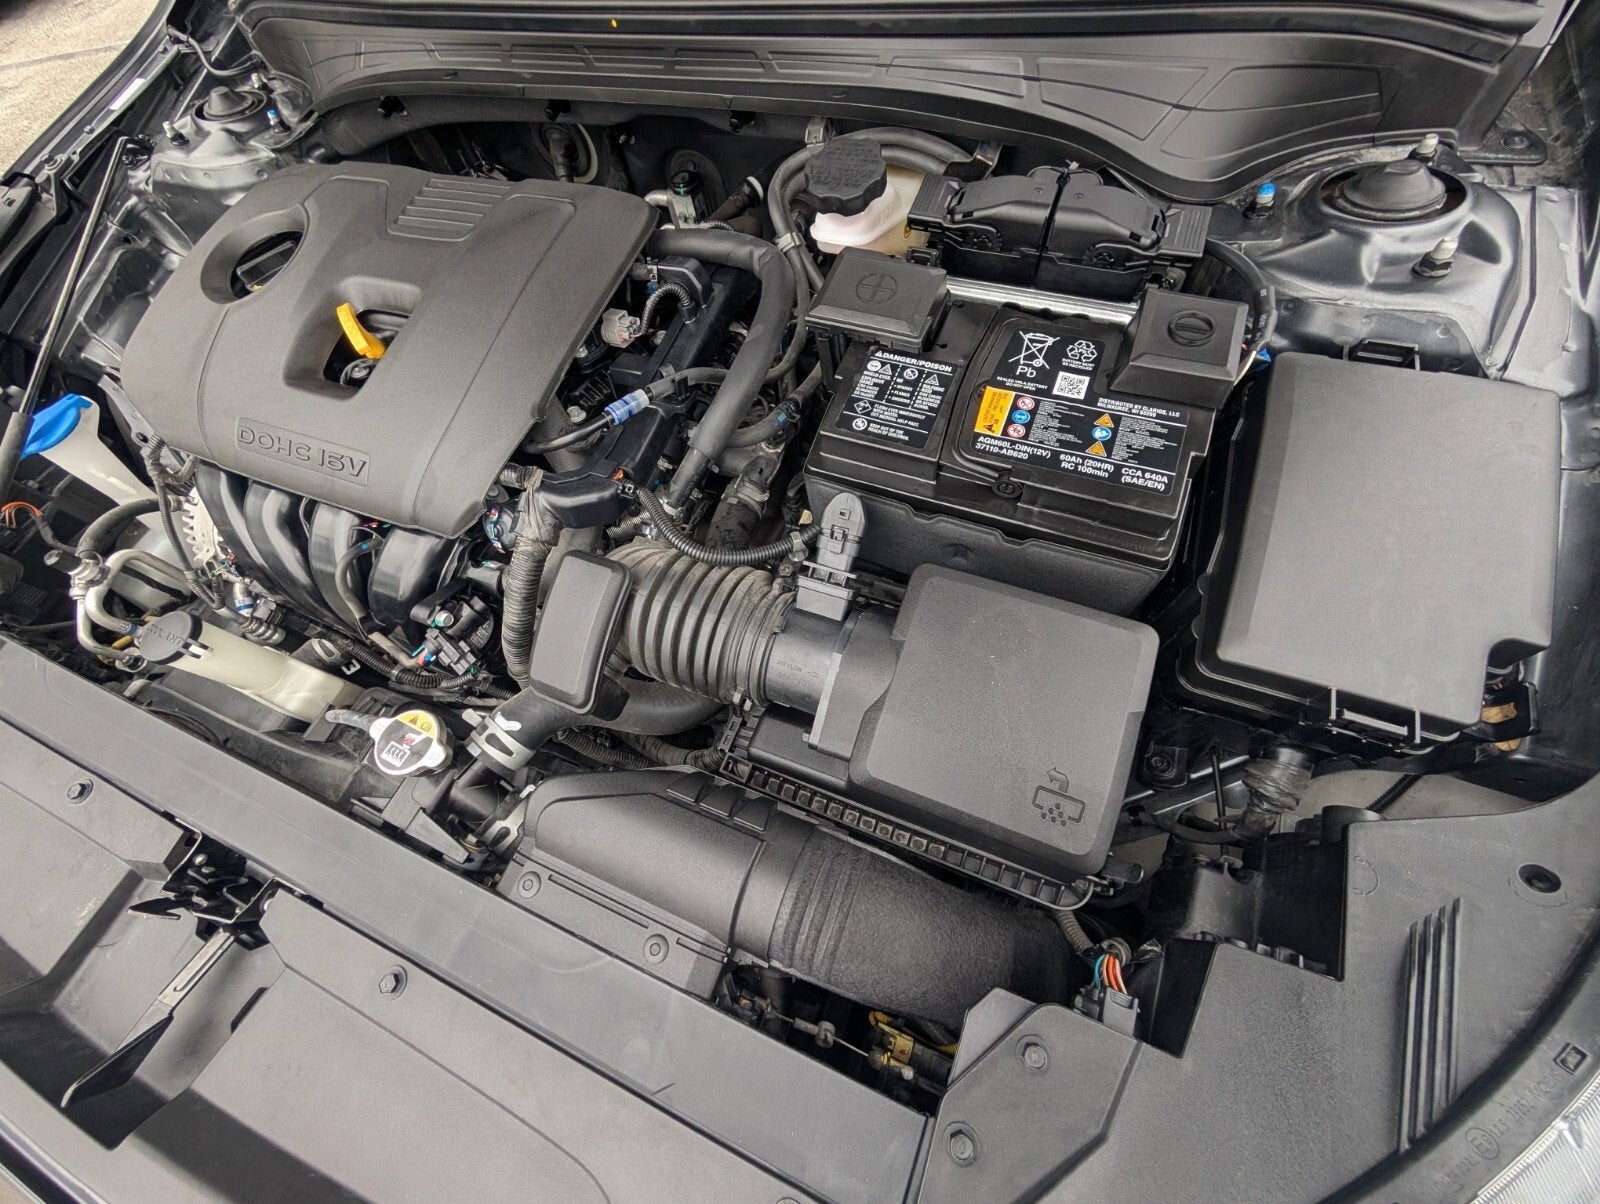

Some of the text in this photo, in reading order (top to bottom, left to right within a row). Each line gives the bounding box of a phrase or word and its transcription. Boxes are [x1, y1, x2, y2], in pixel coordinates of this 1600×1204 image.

[883, 352, 952, 372] DANGER/POISON
[1016, 365, 1036, 378] Pb
[975, 442, 1028, 460] 37110-AB620
[977, 436, 1051, 459] AGM60L-DIN(12V)
[1059, 453, 1114, 473] 60Ah (20HR)
[1060, 461, 1109, 478] RC 100min
[1121, 467, 1168, 484] CCA 640A
[1121, 475, 1165, 492] (SAE/EN)
